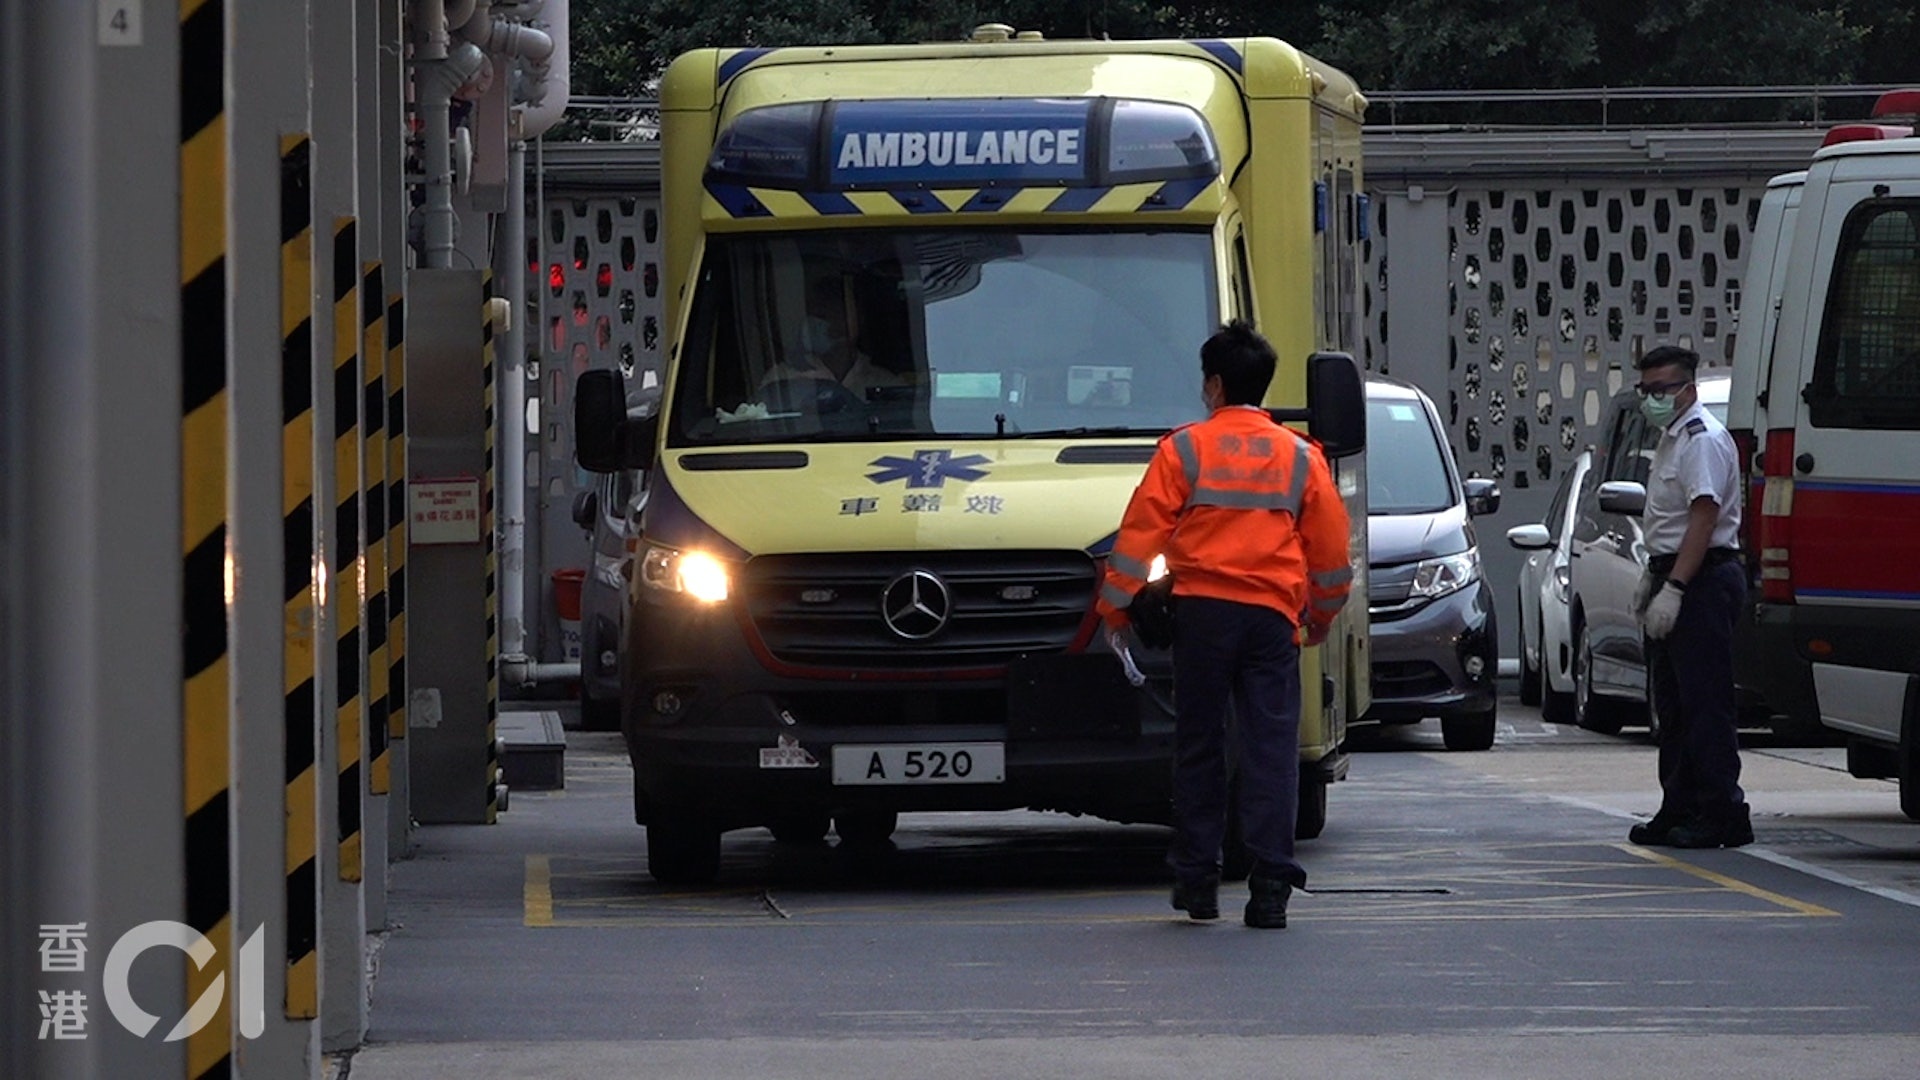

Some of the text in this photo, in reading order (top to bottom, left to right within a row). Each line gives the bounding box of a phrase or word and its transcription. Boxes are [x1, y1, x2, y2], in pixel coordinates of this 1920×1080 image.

[109, 8, 127, 34] 4
[837, 129, 1080, 168] AMBULANCE
[866, 750, 973, 779] A 520
